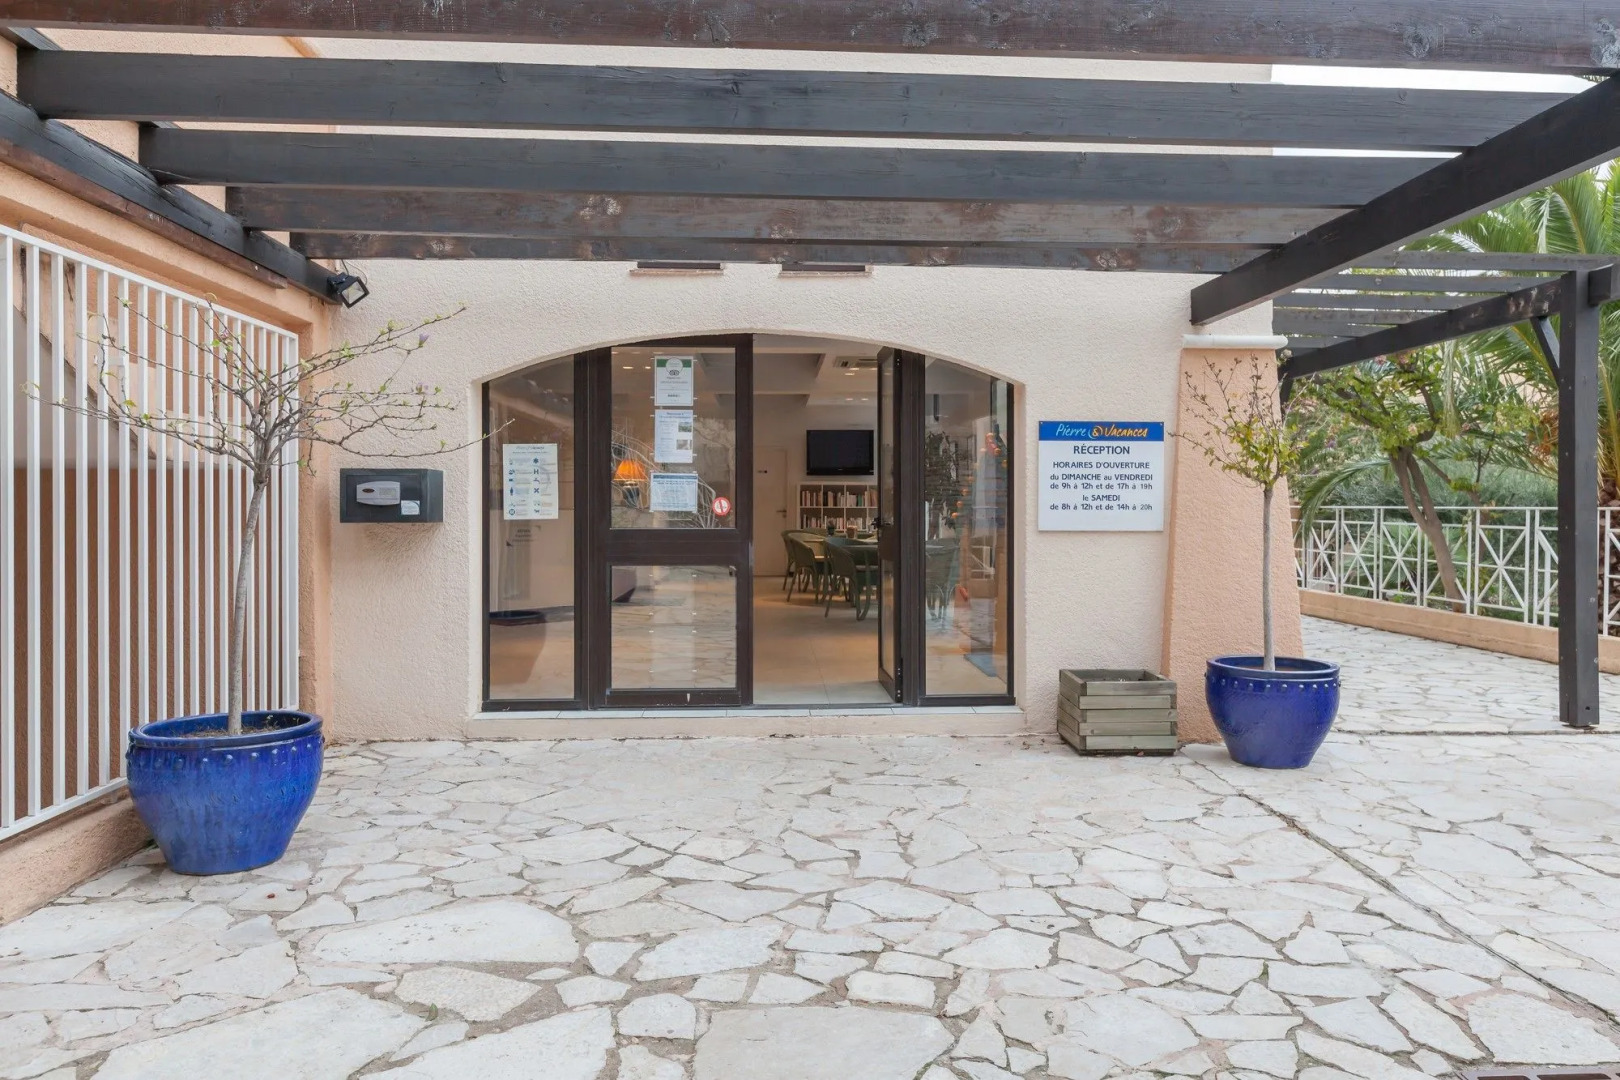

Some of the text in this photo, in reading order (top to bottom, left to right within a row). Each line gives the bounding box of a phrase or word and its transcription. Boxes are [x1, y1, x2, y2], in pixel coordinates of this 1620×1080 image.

[1056, 424, 1086, 436] Pierre
[1104, 425, 1148, 437] Vacances
[1073, 444, 1130, 455] RÉCEPTION
[1053, 461, 1150, 469] HORAIRES D'OUVERTURE
